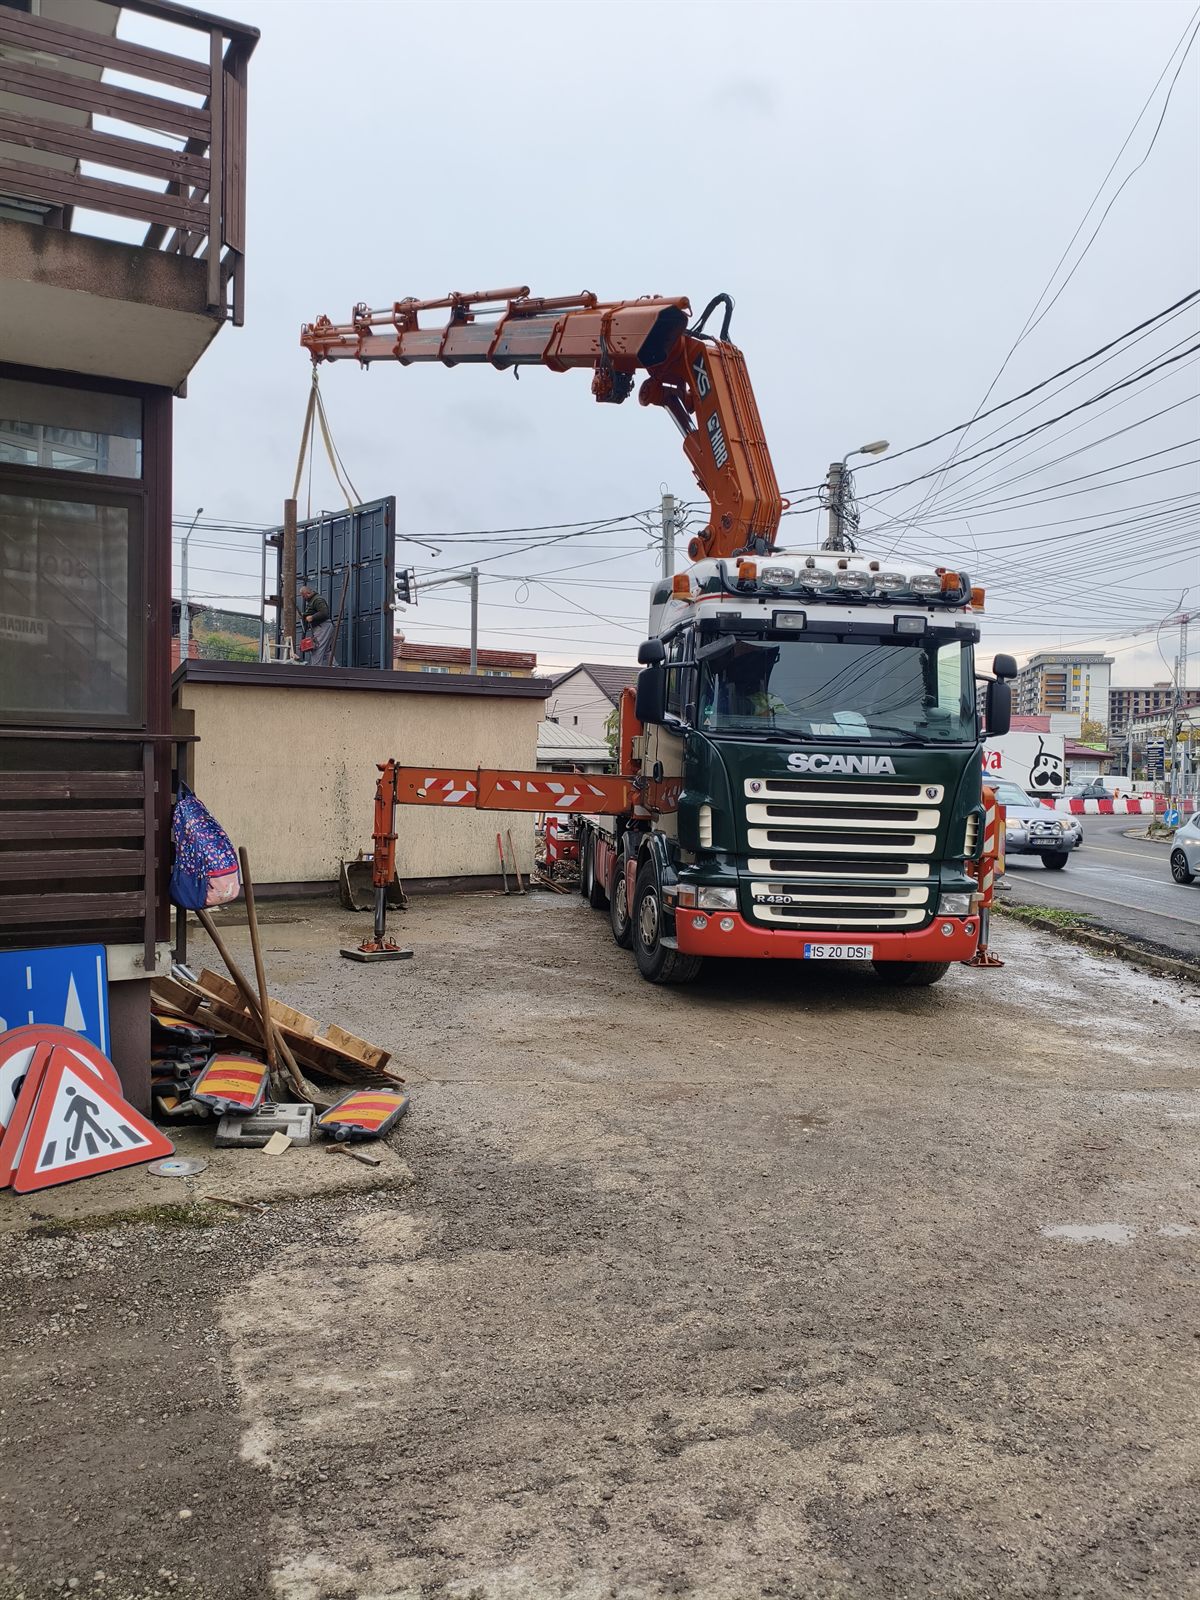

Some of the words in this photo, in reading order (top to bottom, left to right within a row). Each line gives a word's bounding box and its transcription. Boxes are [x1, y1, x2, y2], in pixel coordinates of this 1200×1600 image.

[693, 357, 711, 397] XS
[710, 430, 729, 469] HIAB
[786, 752, 897, 775] SCANIA
[756, 895, 766, 903] R
[766, 895, 792, 904] 420
[828, 946, 842, 958] 20
[847, 946, 867, 958] DSI
